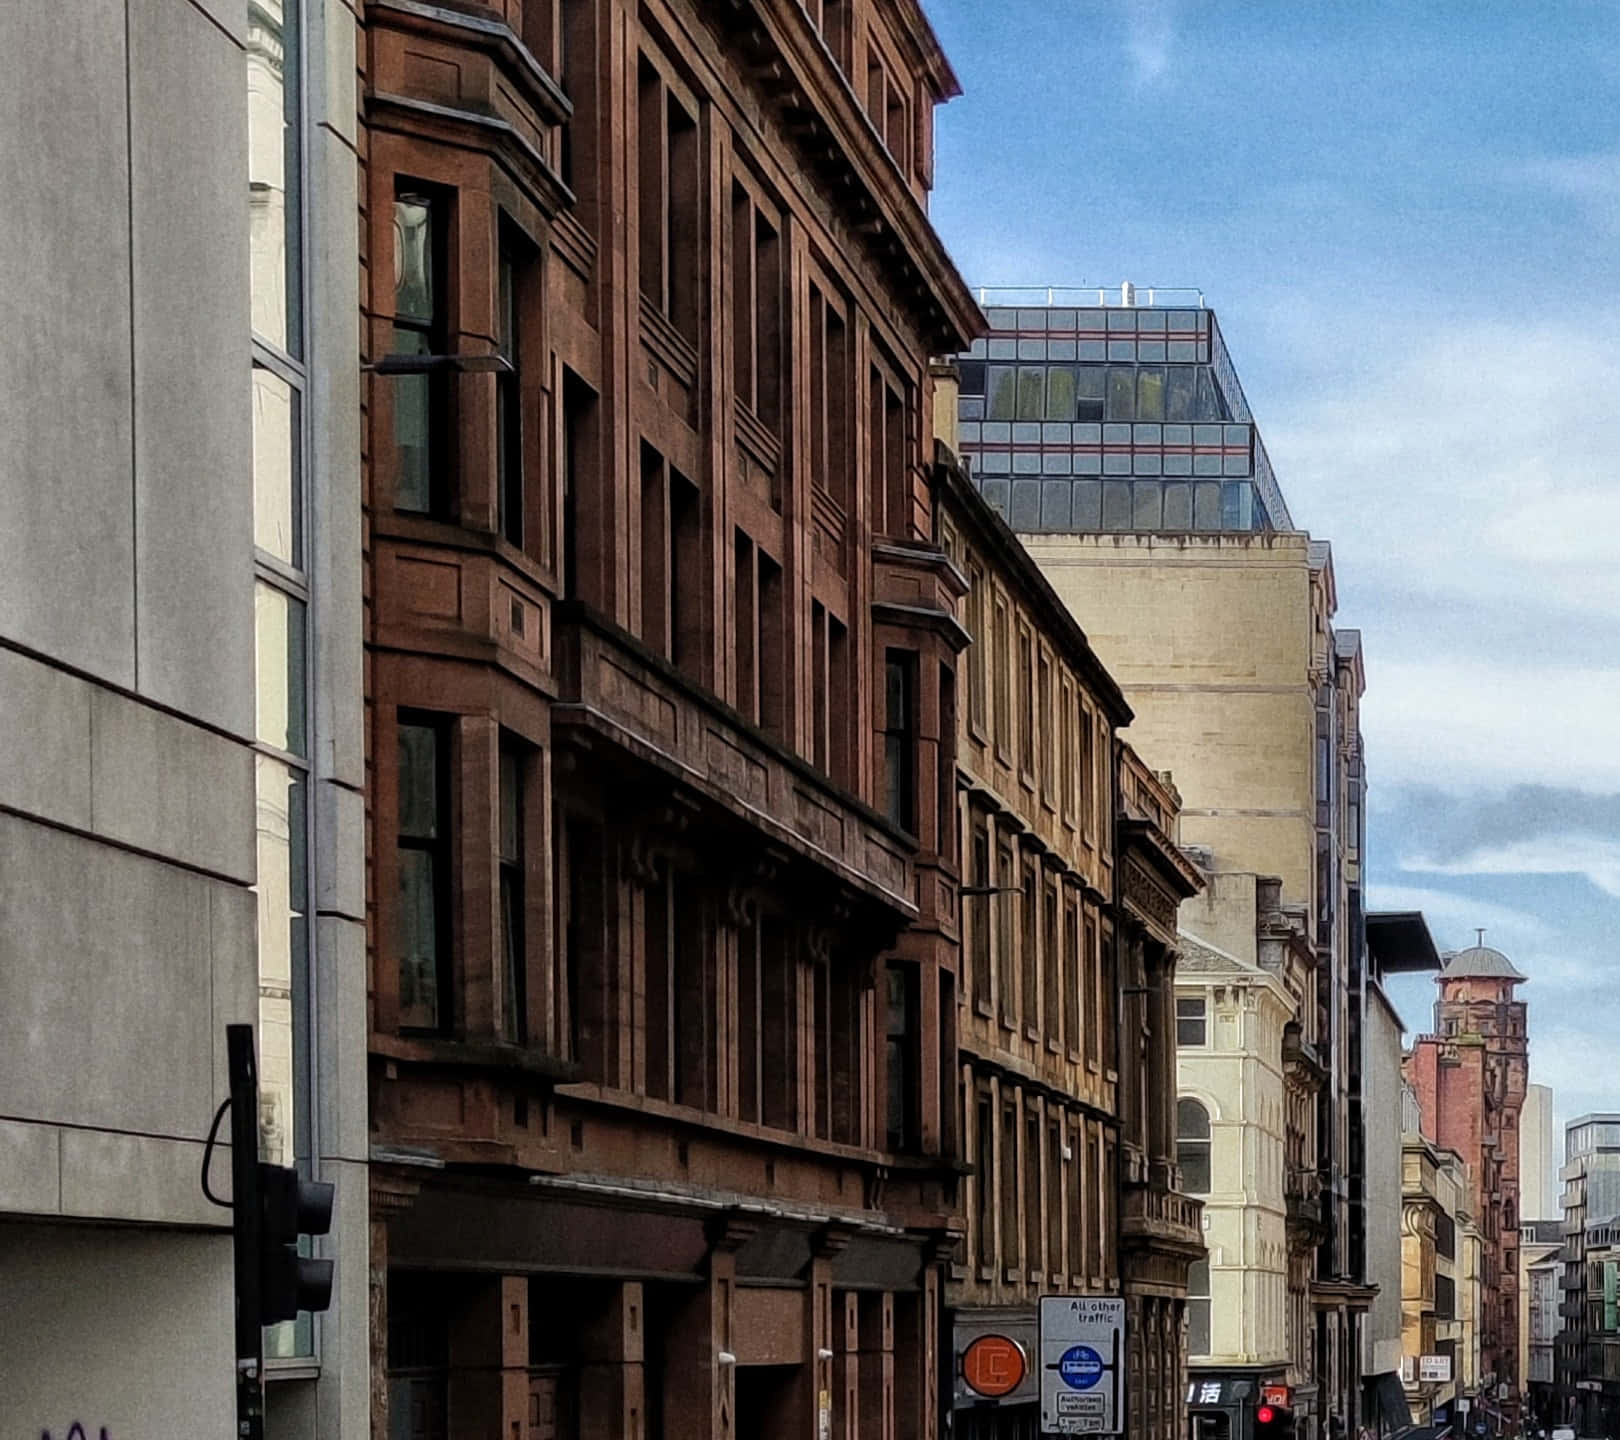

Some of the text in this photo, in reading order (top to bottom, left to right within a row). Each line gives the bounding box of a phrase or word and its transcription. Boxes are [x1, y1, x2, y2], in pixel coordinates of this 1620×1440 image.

[1071, 1301, 1120, 1311] All other
[1079, 1313, 1113, 1323] traffic
